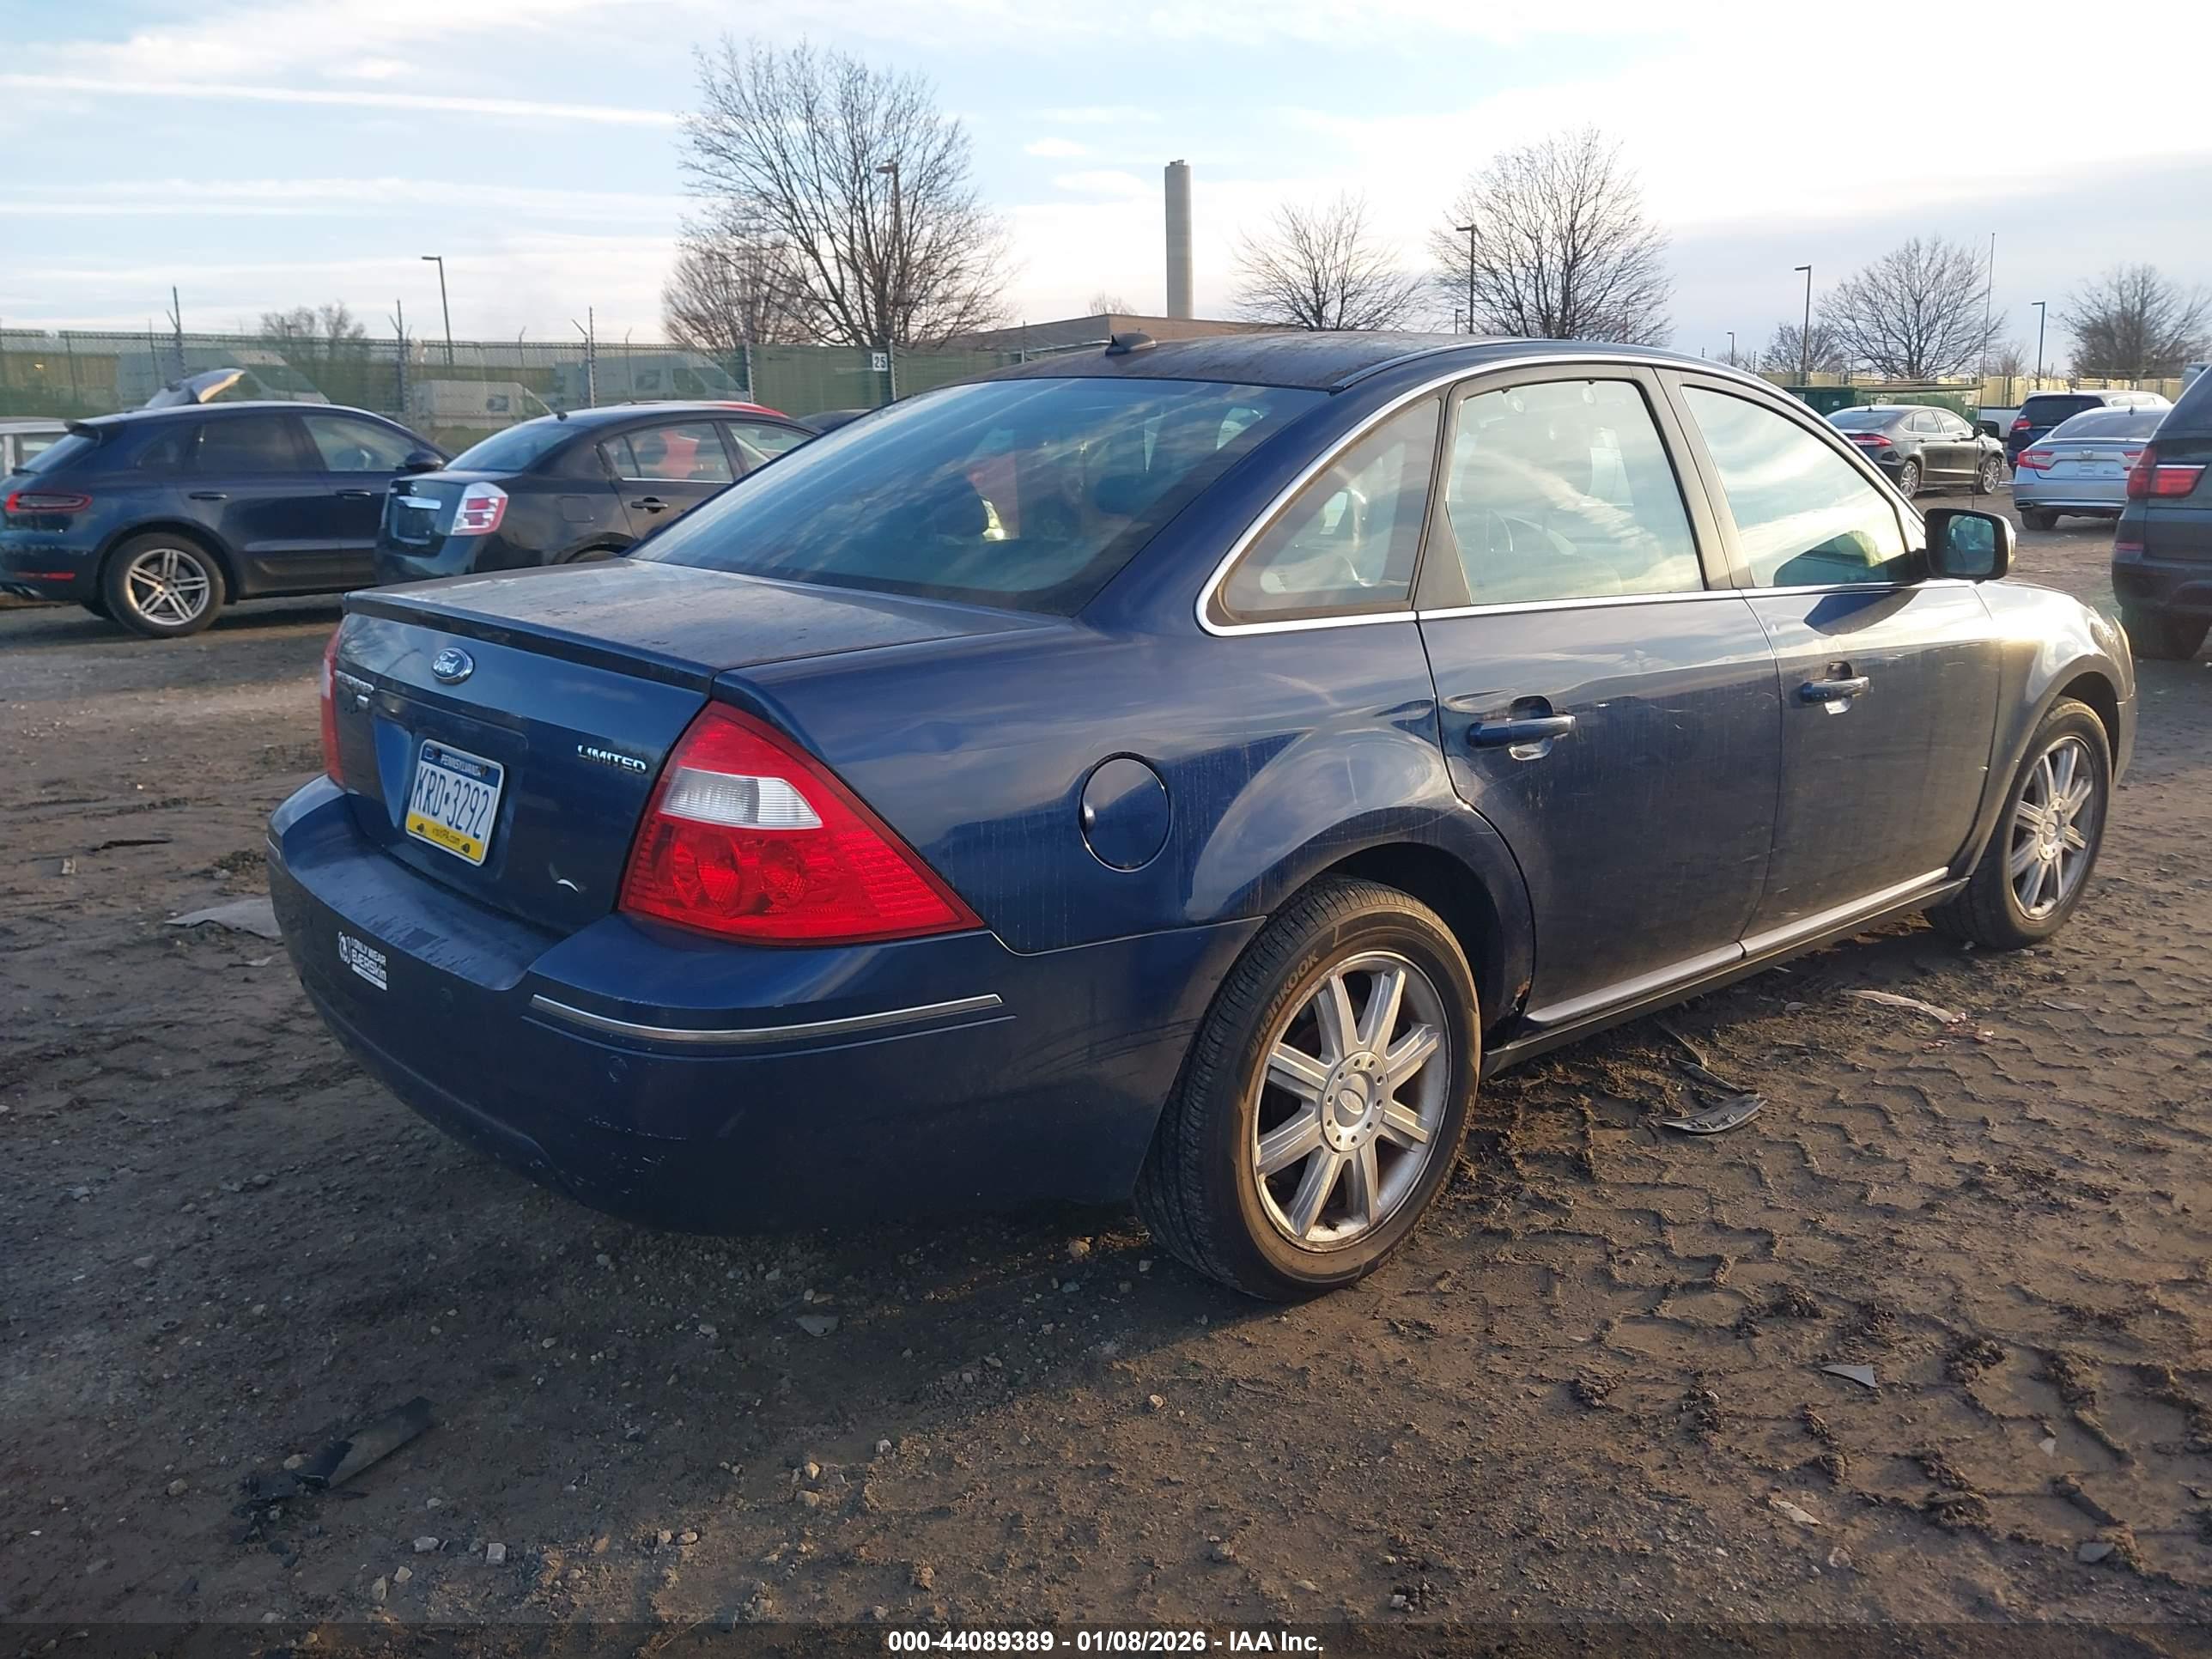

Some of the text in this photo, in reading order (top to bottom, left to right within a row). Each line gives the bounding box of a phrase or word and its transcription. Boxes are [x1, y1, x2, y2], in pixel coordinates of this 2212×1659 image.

[874, 356, 886, 368] 25
[433, 651, 460, 674] Ford
[577, 744, 647, 774] LIMITED
